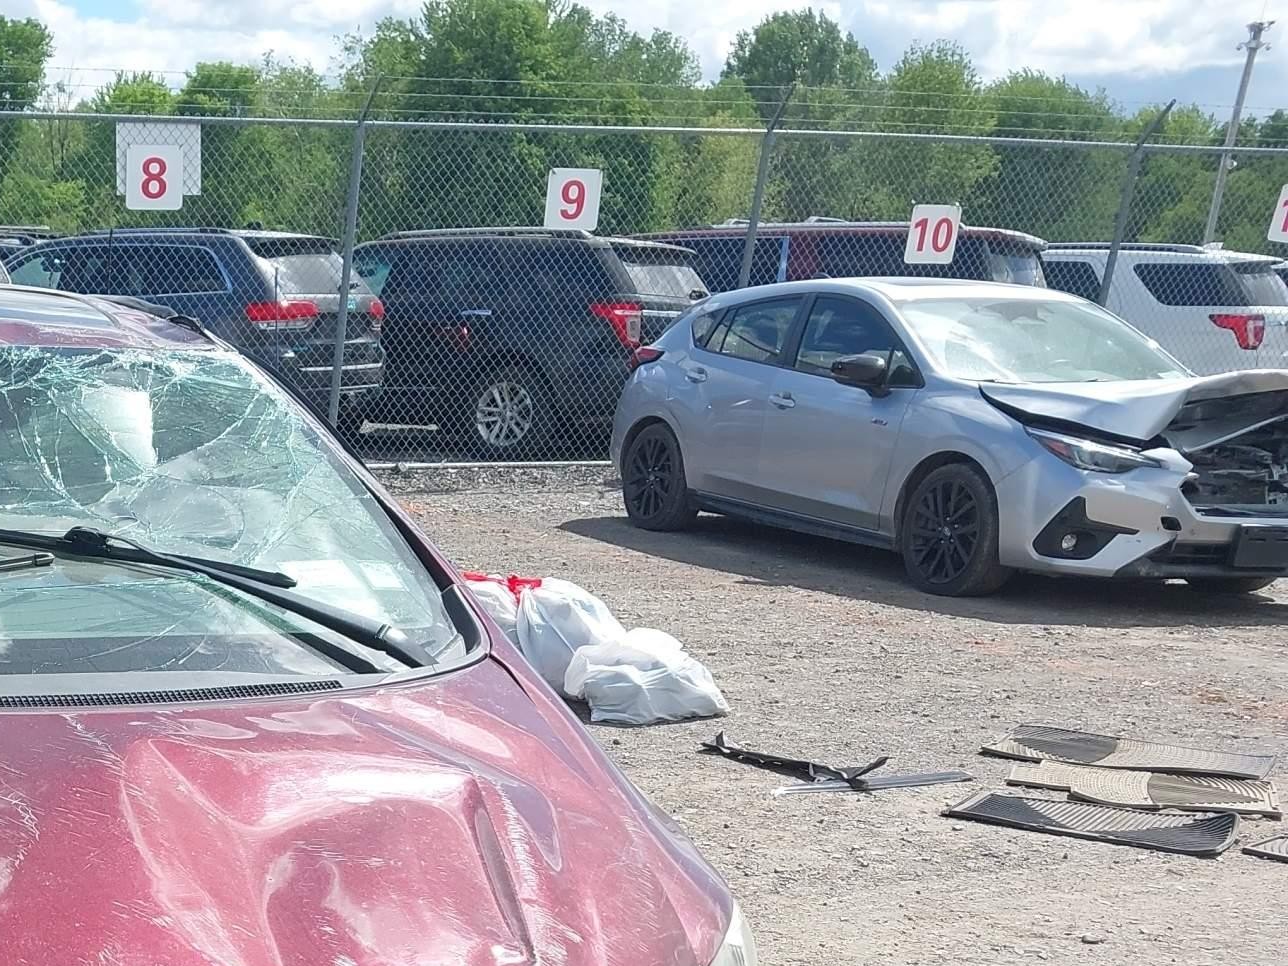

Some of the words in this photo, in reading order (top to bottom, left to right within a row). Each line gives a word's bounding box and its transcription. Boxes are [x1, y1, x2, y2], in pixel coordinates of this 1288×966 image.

[141, 157, 167, 199] 8
[561, 180, 586, 220] 9
[913, 217, 953, 252] 10
